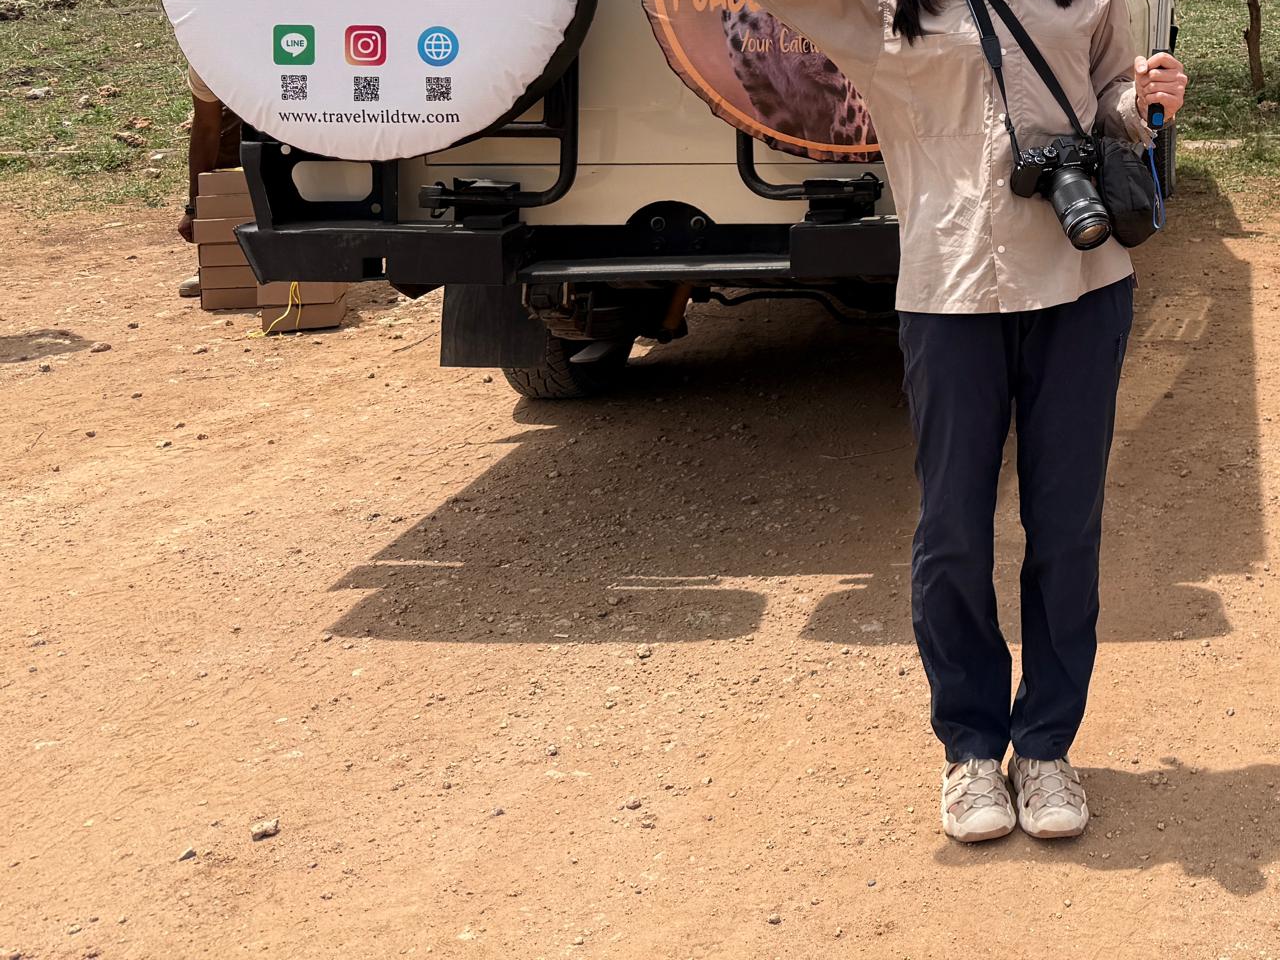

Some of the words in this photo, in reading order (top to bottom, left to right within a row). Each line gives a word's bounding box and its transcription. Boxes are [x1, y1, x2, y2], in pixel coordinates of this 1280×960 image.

[286, 39, 305, 48] LINE
[738, 29, 773, 54] Your
[278, 109, 460, 124] www.travelwildtw.com
